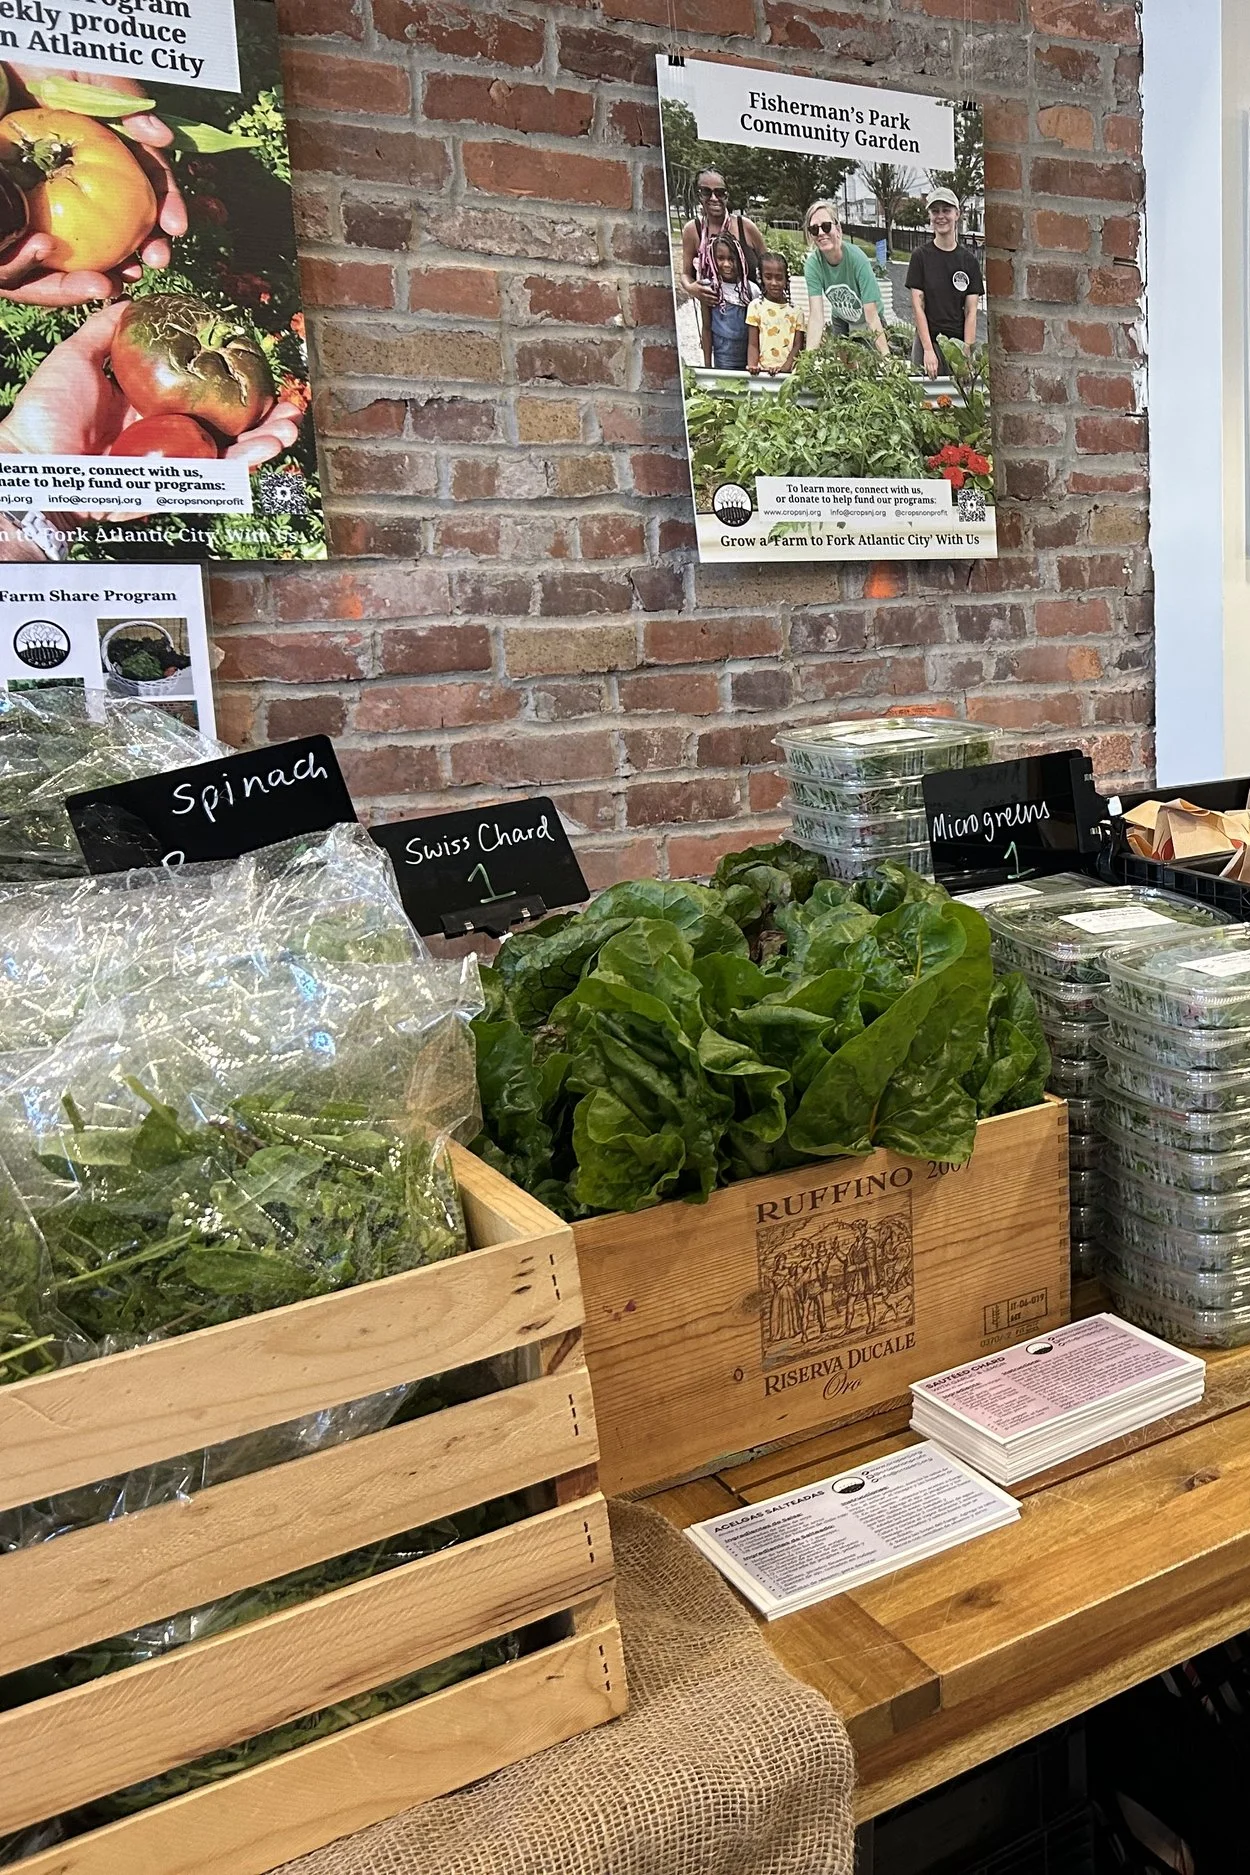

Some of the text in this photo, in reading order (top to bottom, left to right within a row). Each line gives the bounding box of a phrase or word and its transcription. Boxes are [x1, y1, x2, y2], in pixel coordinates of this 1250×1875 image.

[75, 0, 191, 19] gram
[70, 11, 187, 44] produce
[27, 29, 204, 78] Atlantic City
[749, 91, 911, 131] Fisherman's Park
[740, 113, 920, 153] Community Garden
[0, 462, 181, 478] learn more, connect with
[52, 477, 226, 494] help fund our programs:
[48, 494, 245, 507] info@cropsnj.org @cropsnonprofit
[788, 494, 937, 507] donate help fund programs:
[800, 483, 909, 496] learn more, connect with
[95, 527, 175, 543] Atlantic
[720, 535, 756, 547] Grow
[826, 535, 855, 547] Fork
[858, 534, 906, 547] Atlantic
[936, 534, 963, 546] With
[966, 534, 980, 546] Us
[0, 590, 178, 604] Farm Share Program
[171, 751, 329, 824] Spinach
[405, 814, 555, 866] Swiss Chard
[1003, 841, 1036, 880] 1
[467, 863, 517, 905] 1
[756, 1166, 913, 1225] RUFFINO
[764, 1331, 916, 1397] RISERVA DUCALE
[971, 1356, 1006, 1372] CHARD
[822, 1370, 863, 1401] Oro
[714, 1490, 826, 1533] ACELGAS SALTEADAS
